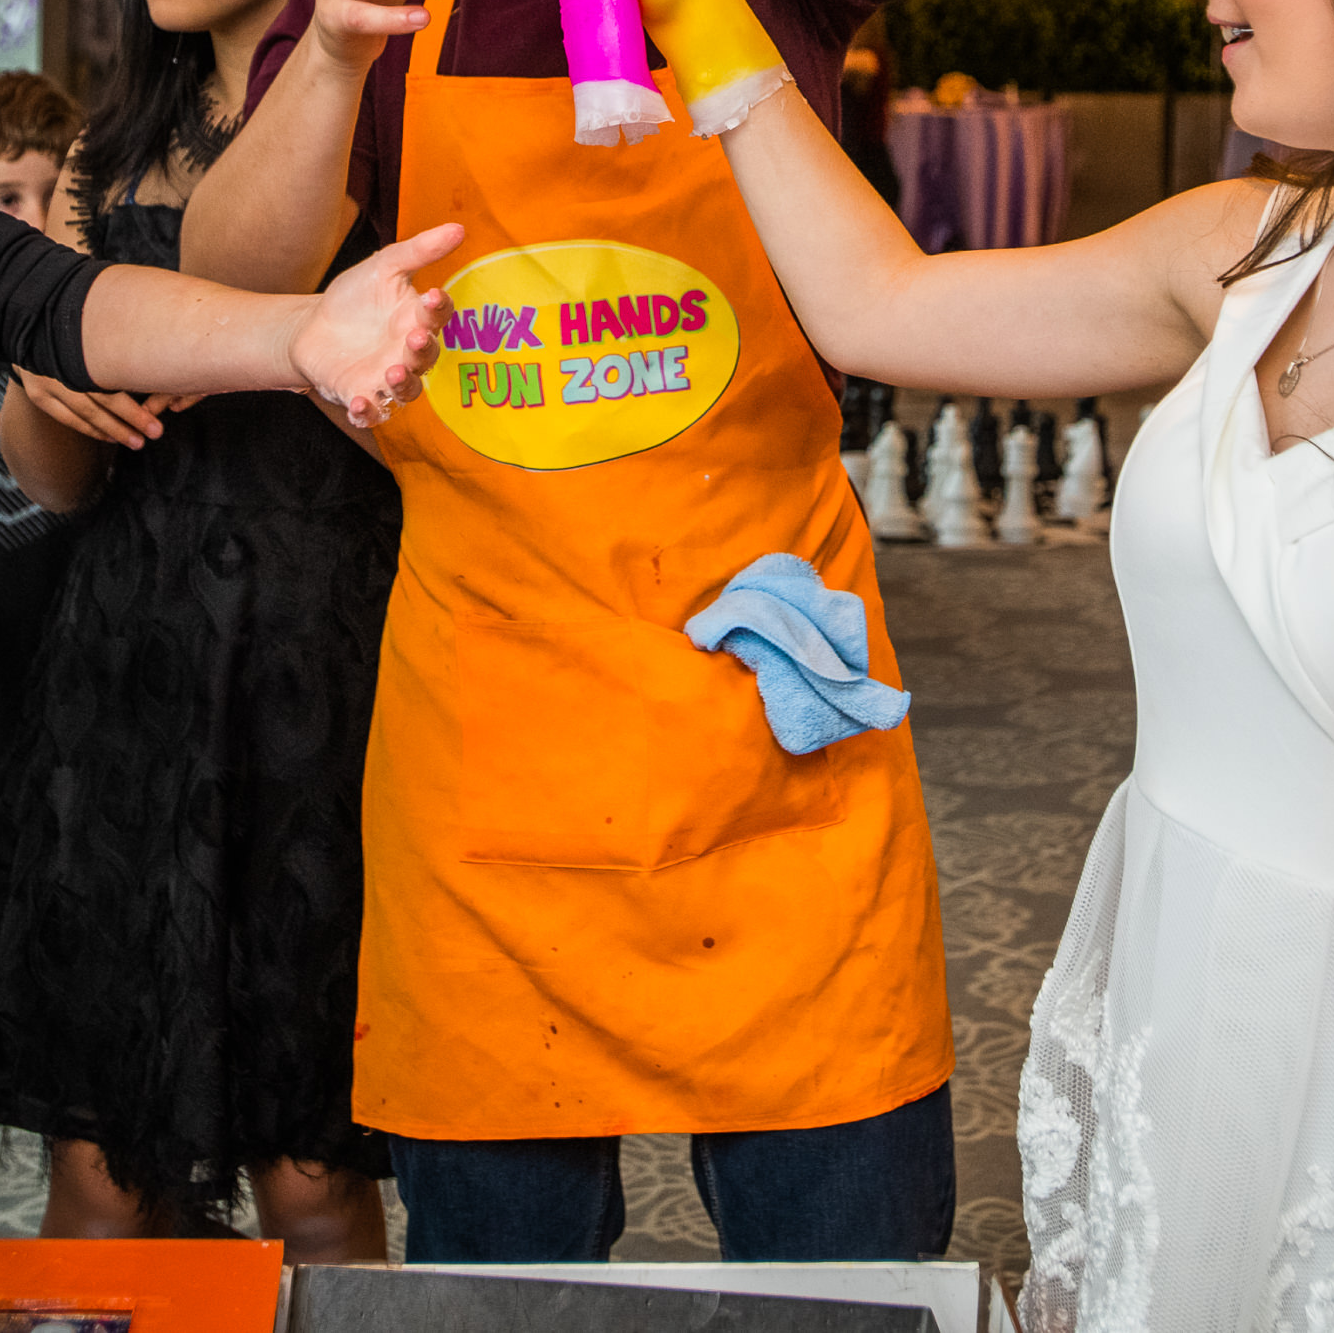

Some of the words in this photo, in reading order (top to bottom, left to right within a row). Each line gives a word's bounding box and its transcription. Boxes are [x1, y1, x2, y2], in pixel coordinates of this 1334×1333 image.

[560, 289, 708, 348] HANDS
[458, 361, 545, 409] FUN
[560, 345, 691, 404] ZONE
